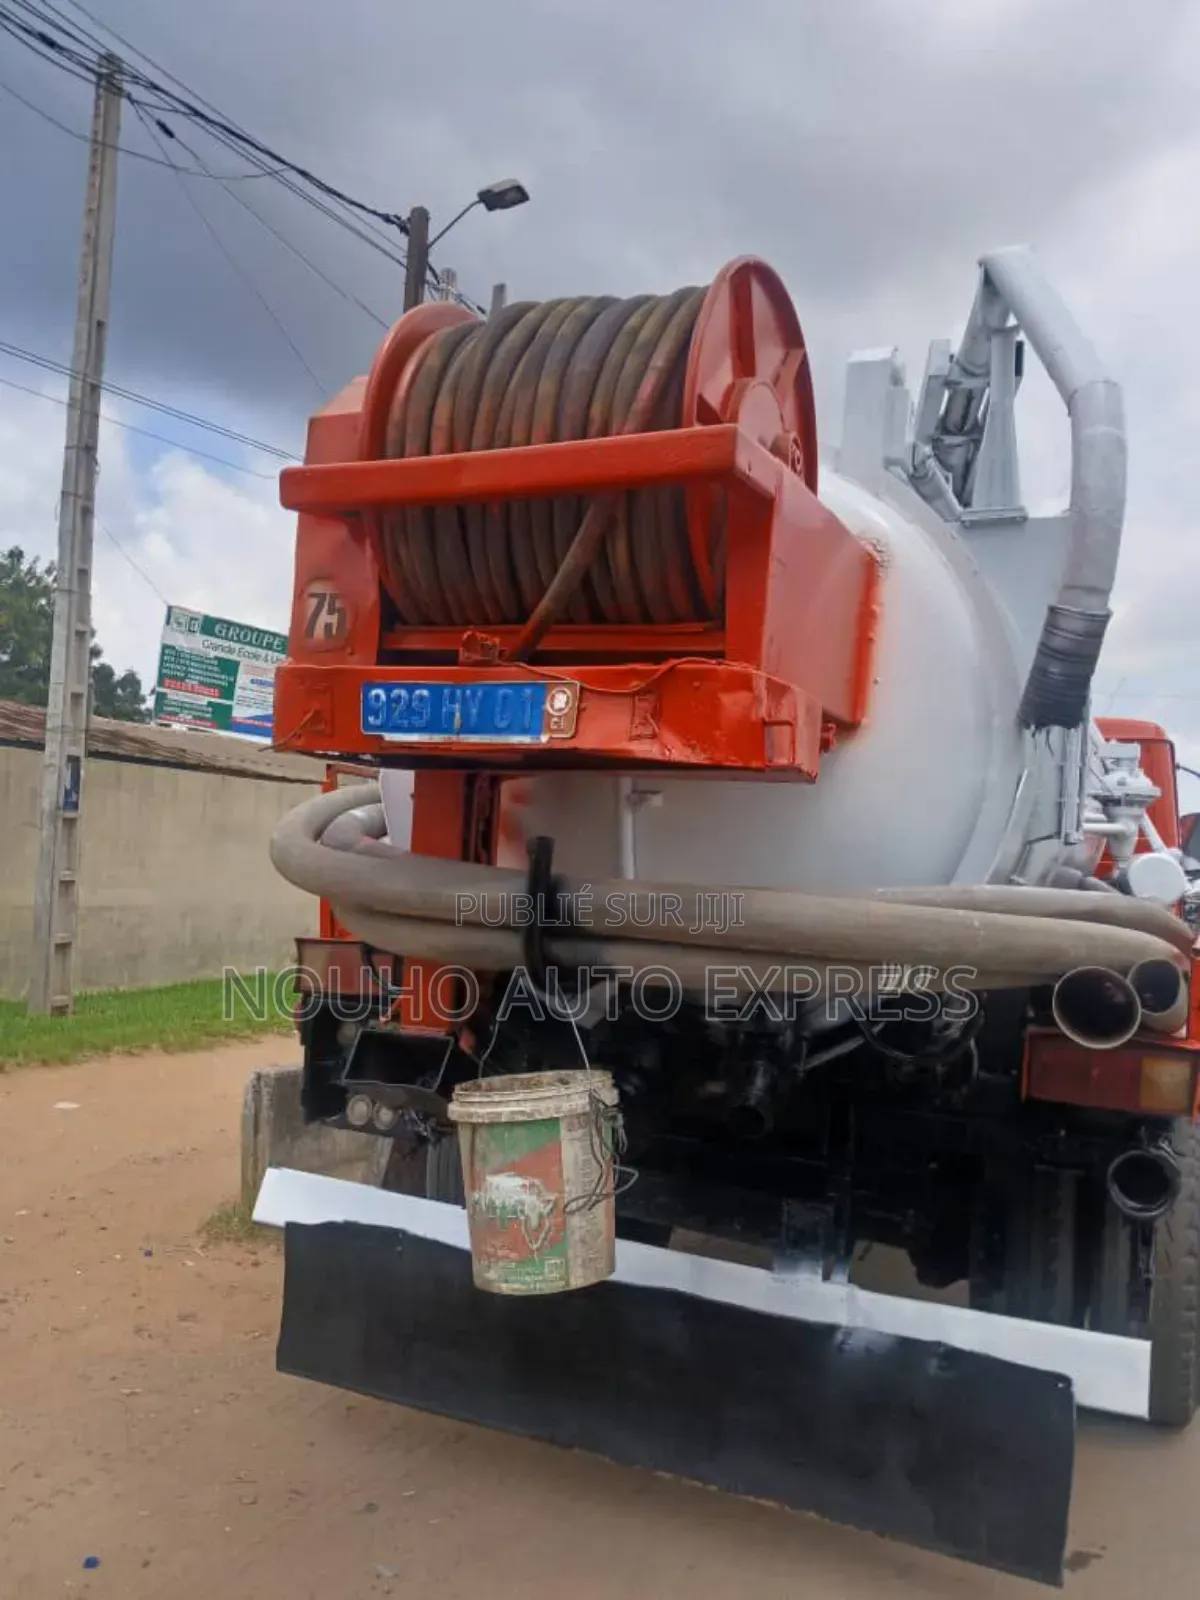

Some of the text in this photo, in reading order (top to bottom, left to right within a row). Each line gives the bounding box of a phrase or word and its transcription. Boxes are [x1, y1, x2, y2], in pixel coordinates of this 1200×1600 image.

[304, 591, 347, 639] 75
[214, 622, 284, 650] GROUPE
[367, 687, 431, 728] 929
[494, 687, 534, 728] 01
